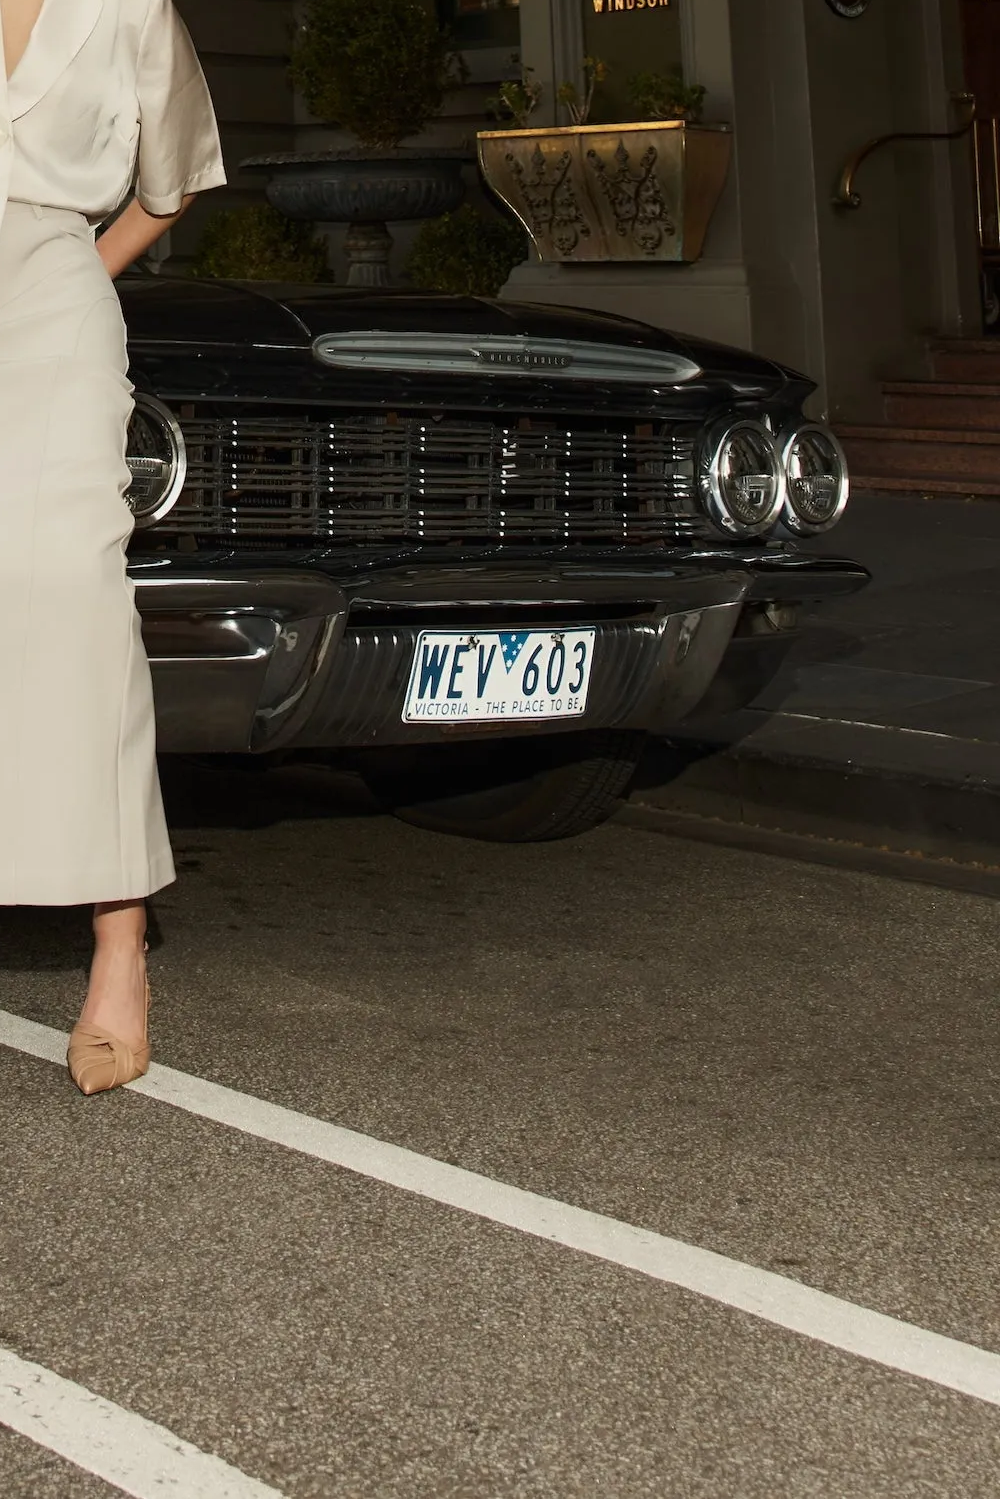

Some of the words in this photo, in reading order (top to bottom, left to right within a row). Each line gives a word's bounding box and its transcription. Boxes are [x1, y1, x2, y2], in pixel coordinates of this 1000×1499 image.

[417, 644, 497, 699] WEV
[521, 641, 587, 696] 603
[415, 703, 469, 716] VICTORIA
[486, 701, 506, 714] THE
[512, 699, 545, 713] PLACE
[550, 699, 563, 711] TO
[567, 697, 579, 710] BE
